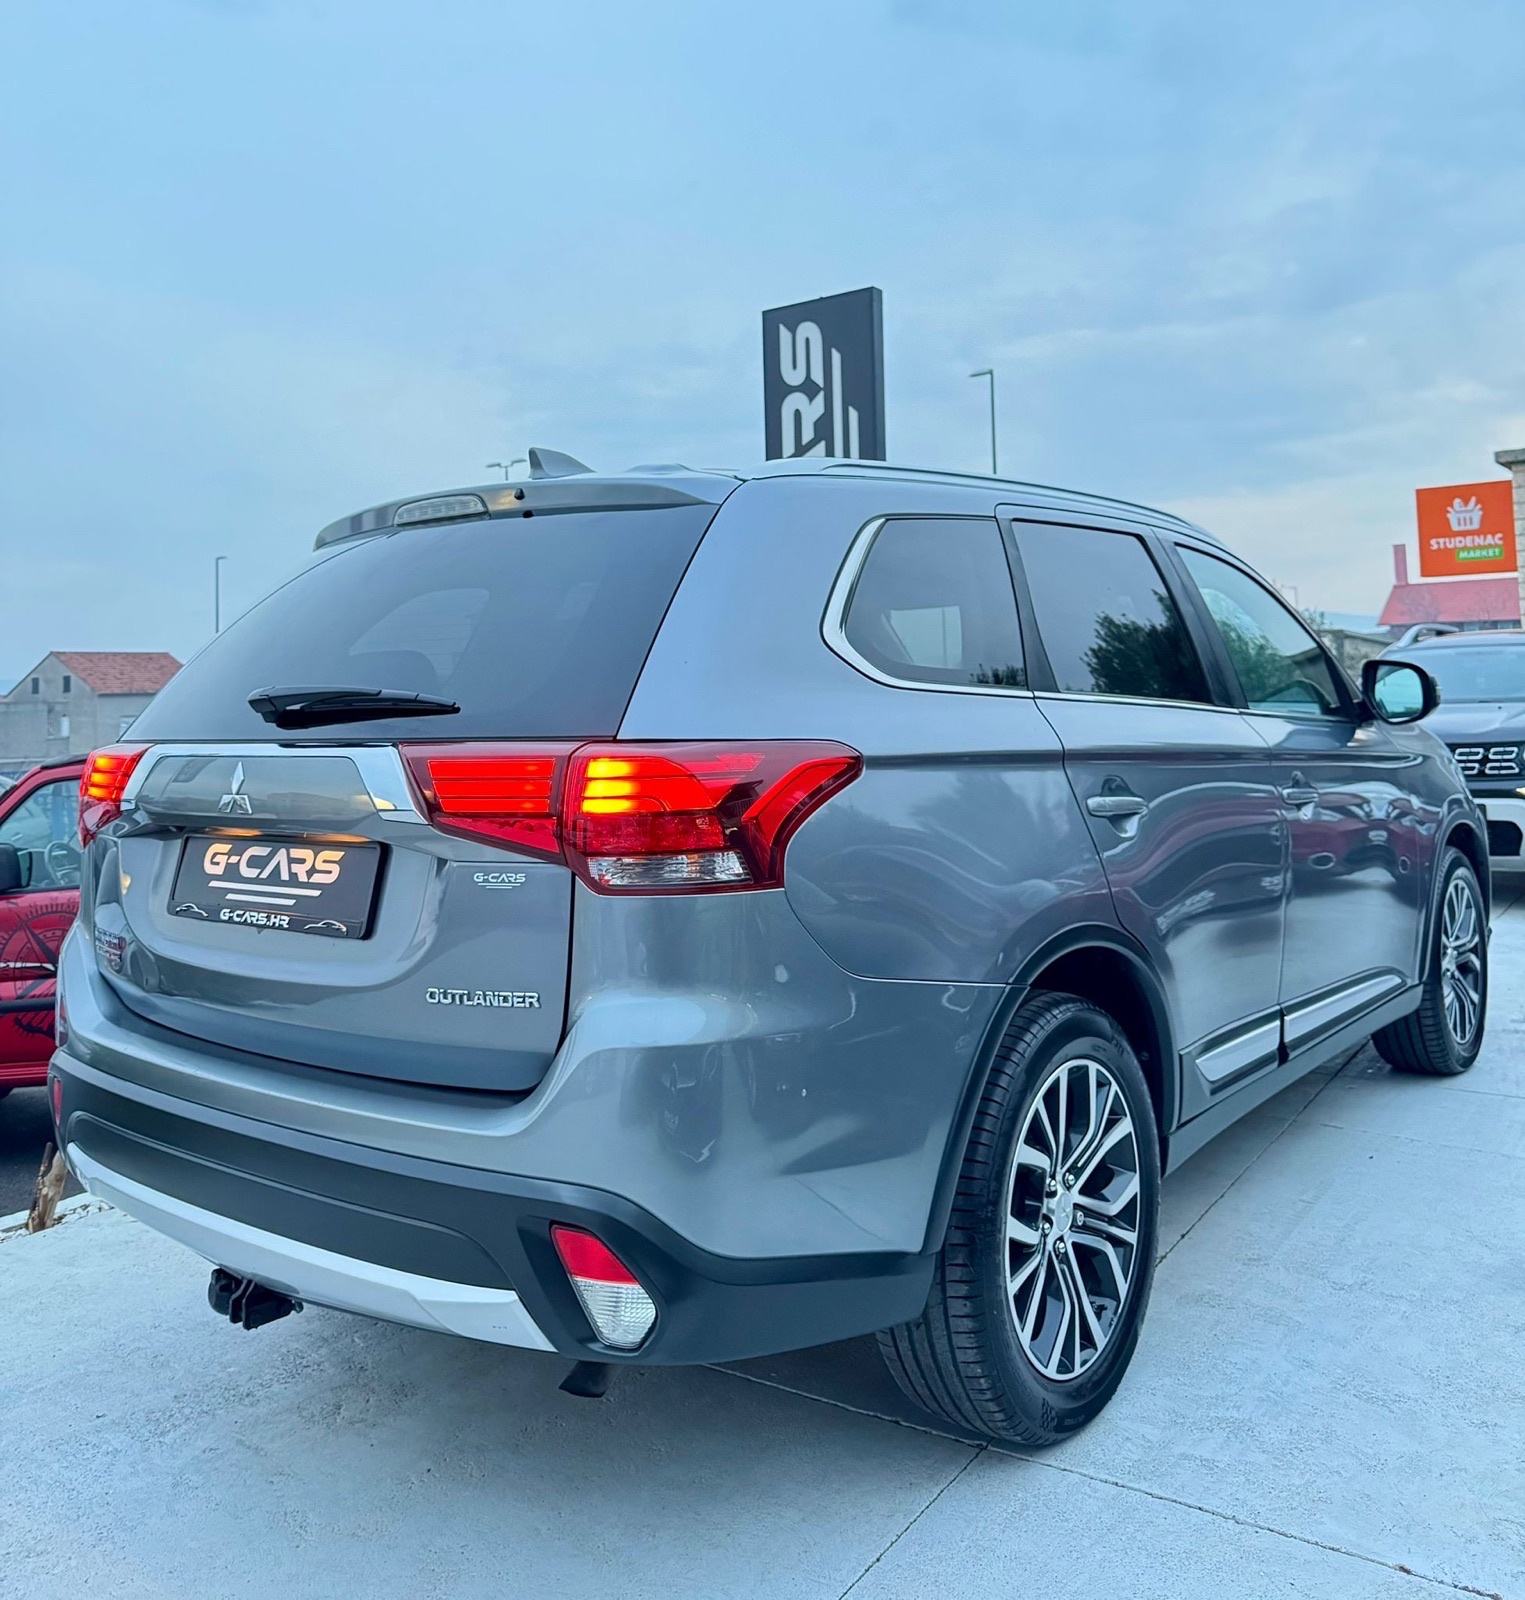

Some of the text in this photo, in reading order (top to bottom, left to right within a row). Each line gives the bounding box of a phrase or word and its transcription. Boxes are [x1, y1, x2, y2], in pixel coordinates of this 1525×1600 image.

[778, 320, 826, 459] RS
[1430, 533, 1503, 550] STUDENAC
[1459, 548, 1500, 560] MARKET
[203, 843, 345, 884] G-CARS
[473, 872, 526, 883] G-CARS
[219, 908, 290, 928] G-CARS.HR
[426, 987, 540, 1008] OUTLANDER
